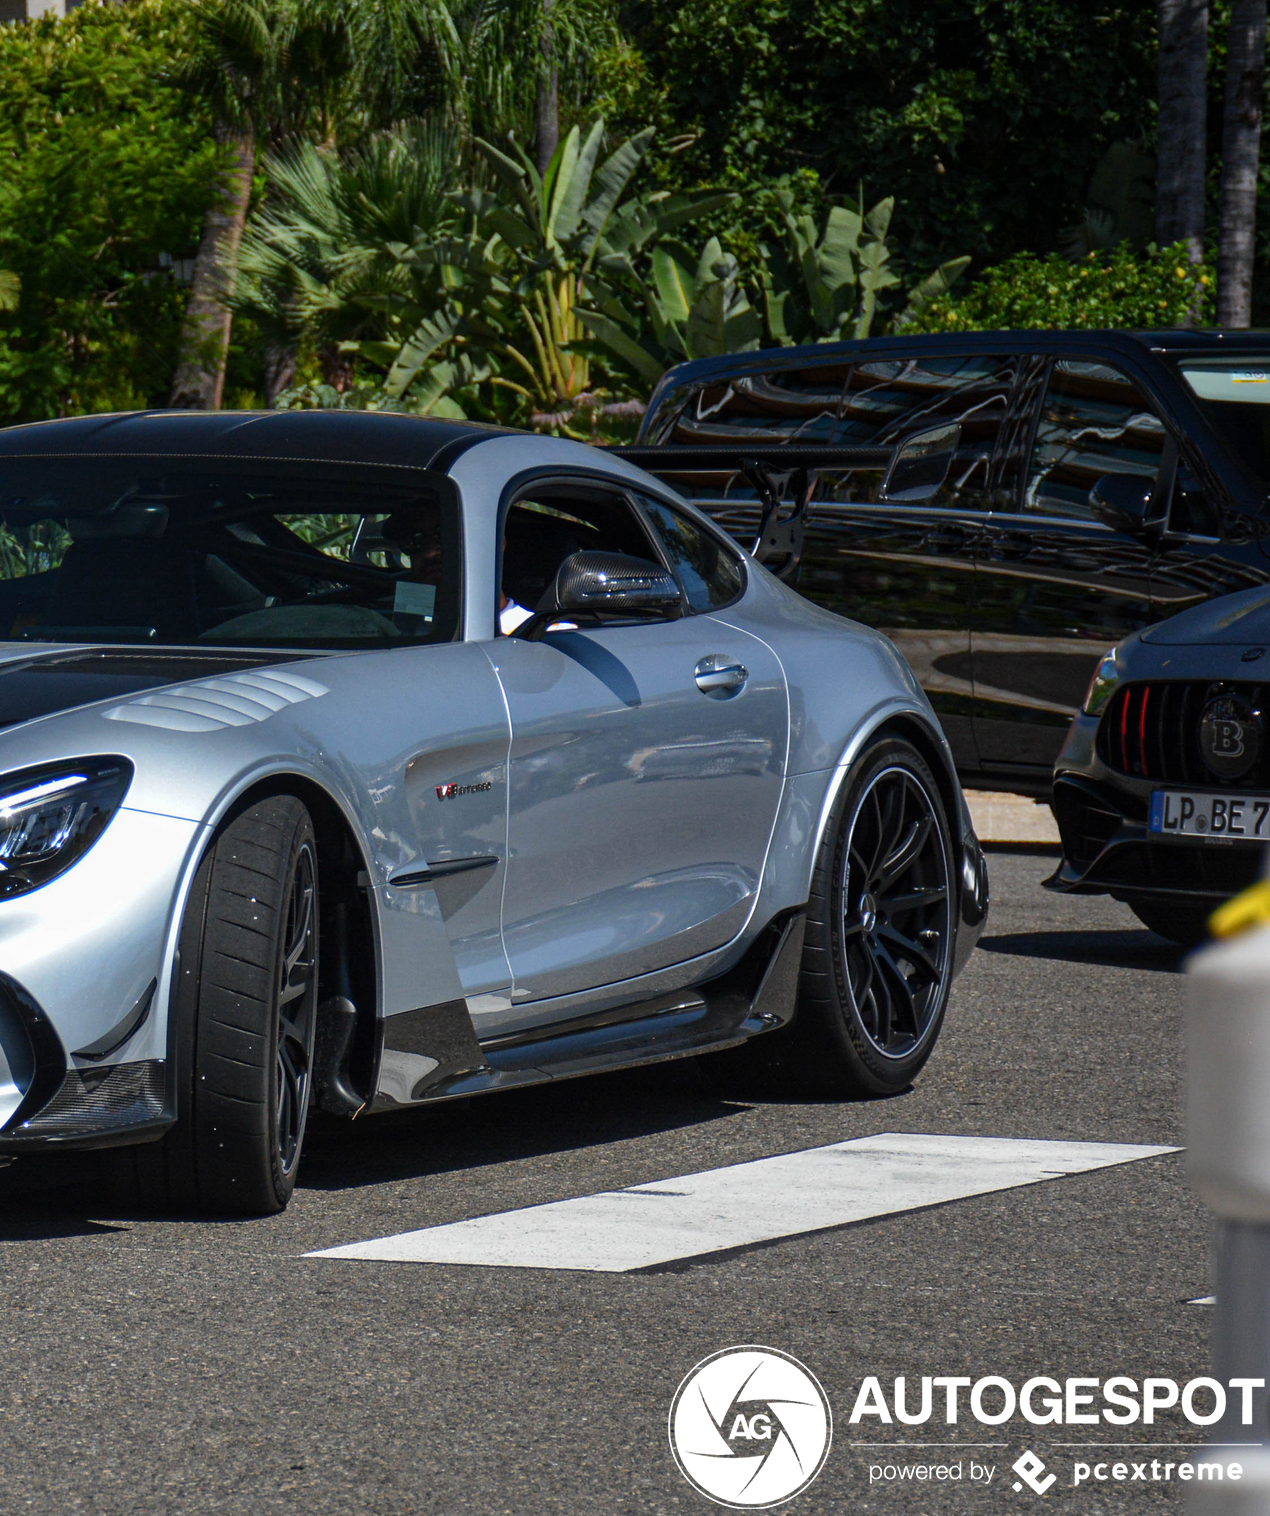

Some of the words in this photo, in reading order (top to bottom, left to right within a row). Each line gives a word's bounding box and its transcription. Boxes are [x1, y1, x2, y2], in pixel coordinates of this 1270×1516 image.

[1212, 719, 1244, 758] B
[1163, 795, 1195, 830] LP
[1210, 798, 1246, 835] BE
